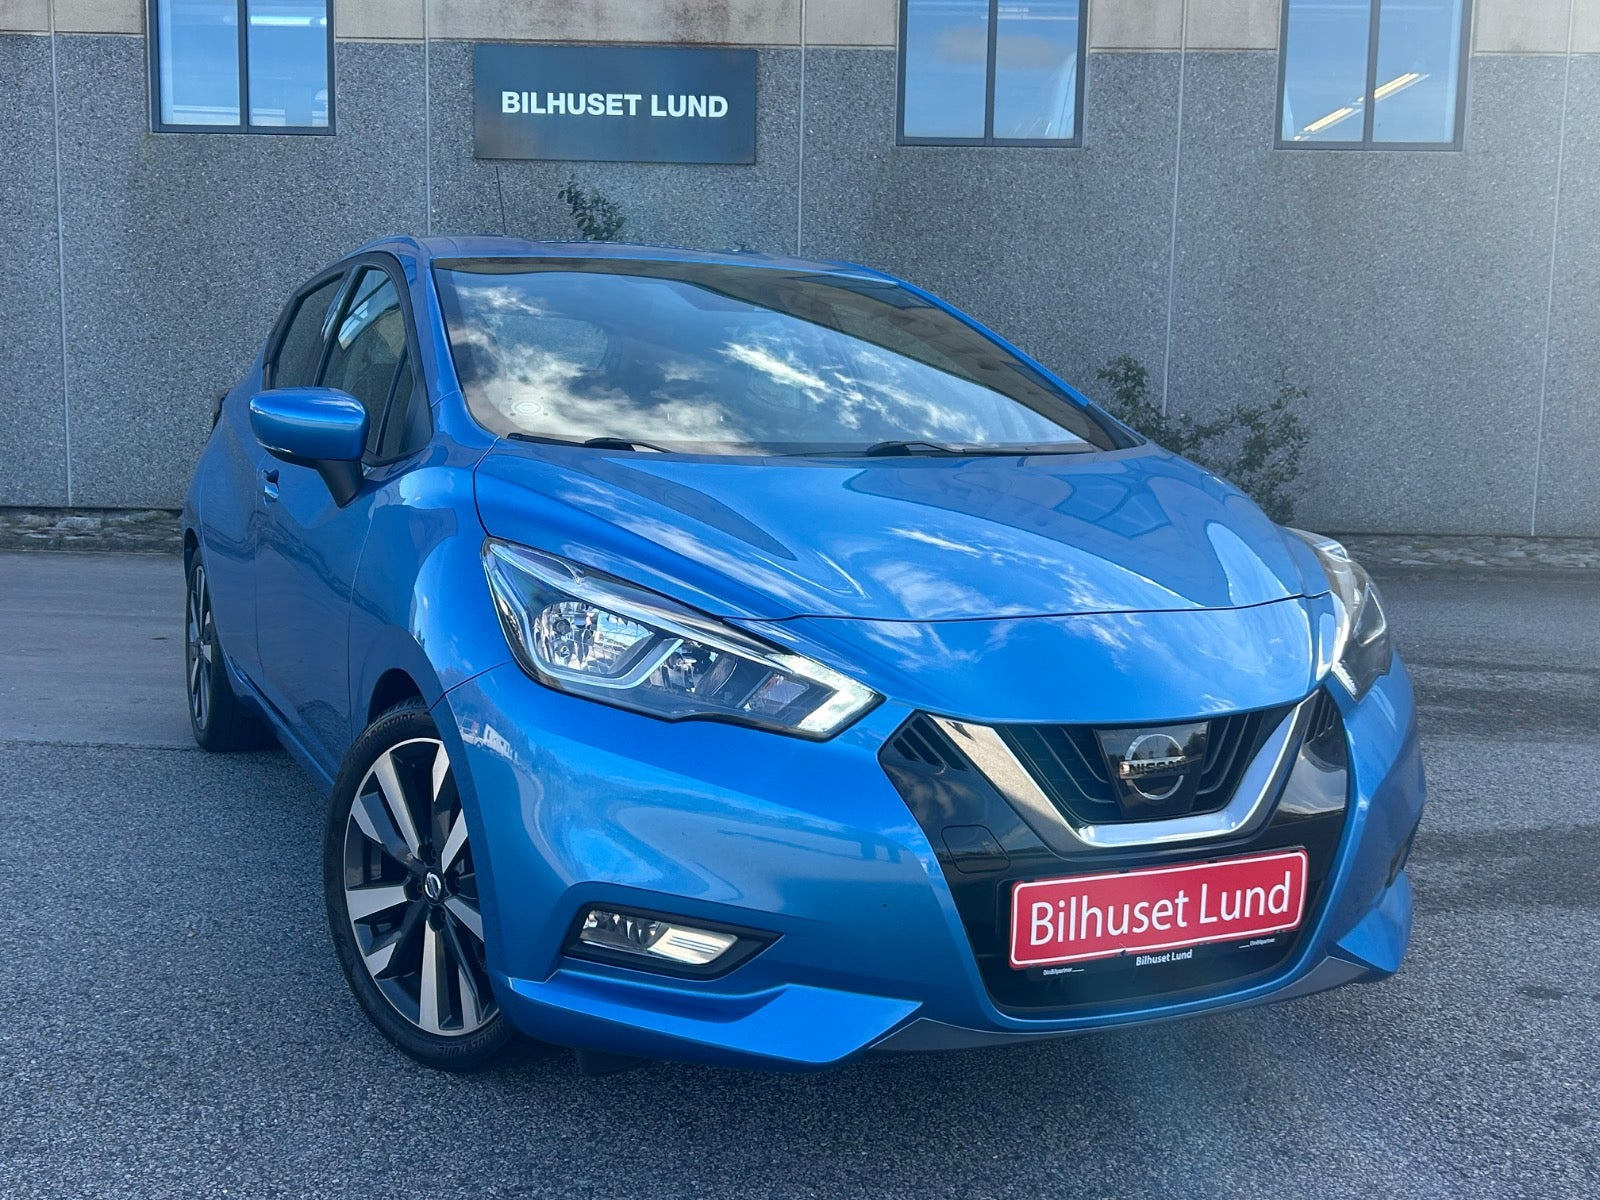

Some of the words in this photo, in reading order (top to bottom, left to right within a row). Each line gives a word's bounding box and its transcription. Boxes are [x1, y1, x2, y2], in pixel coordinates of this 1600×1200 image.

[502, 91, 642, 115] BILHUSET
[651, 95, 728, 117] LUND
[1030, 890, 1188, 946] Bilhuset
[1200, 870, 1291, 924] Lund
[1136, 954, 1170, 966] Bilhuset
[1172, 949, 1192, 960] Lund
